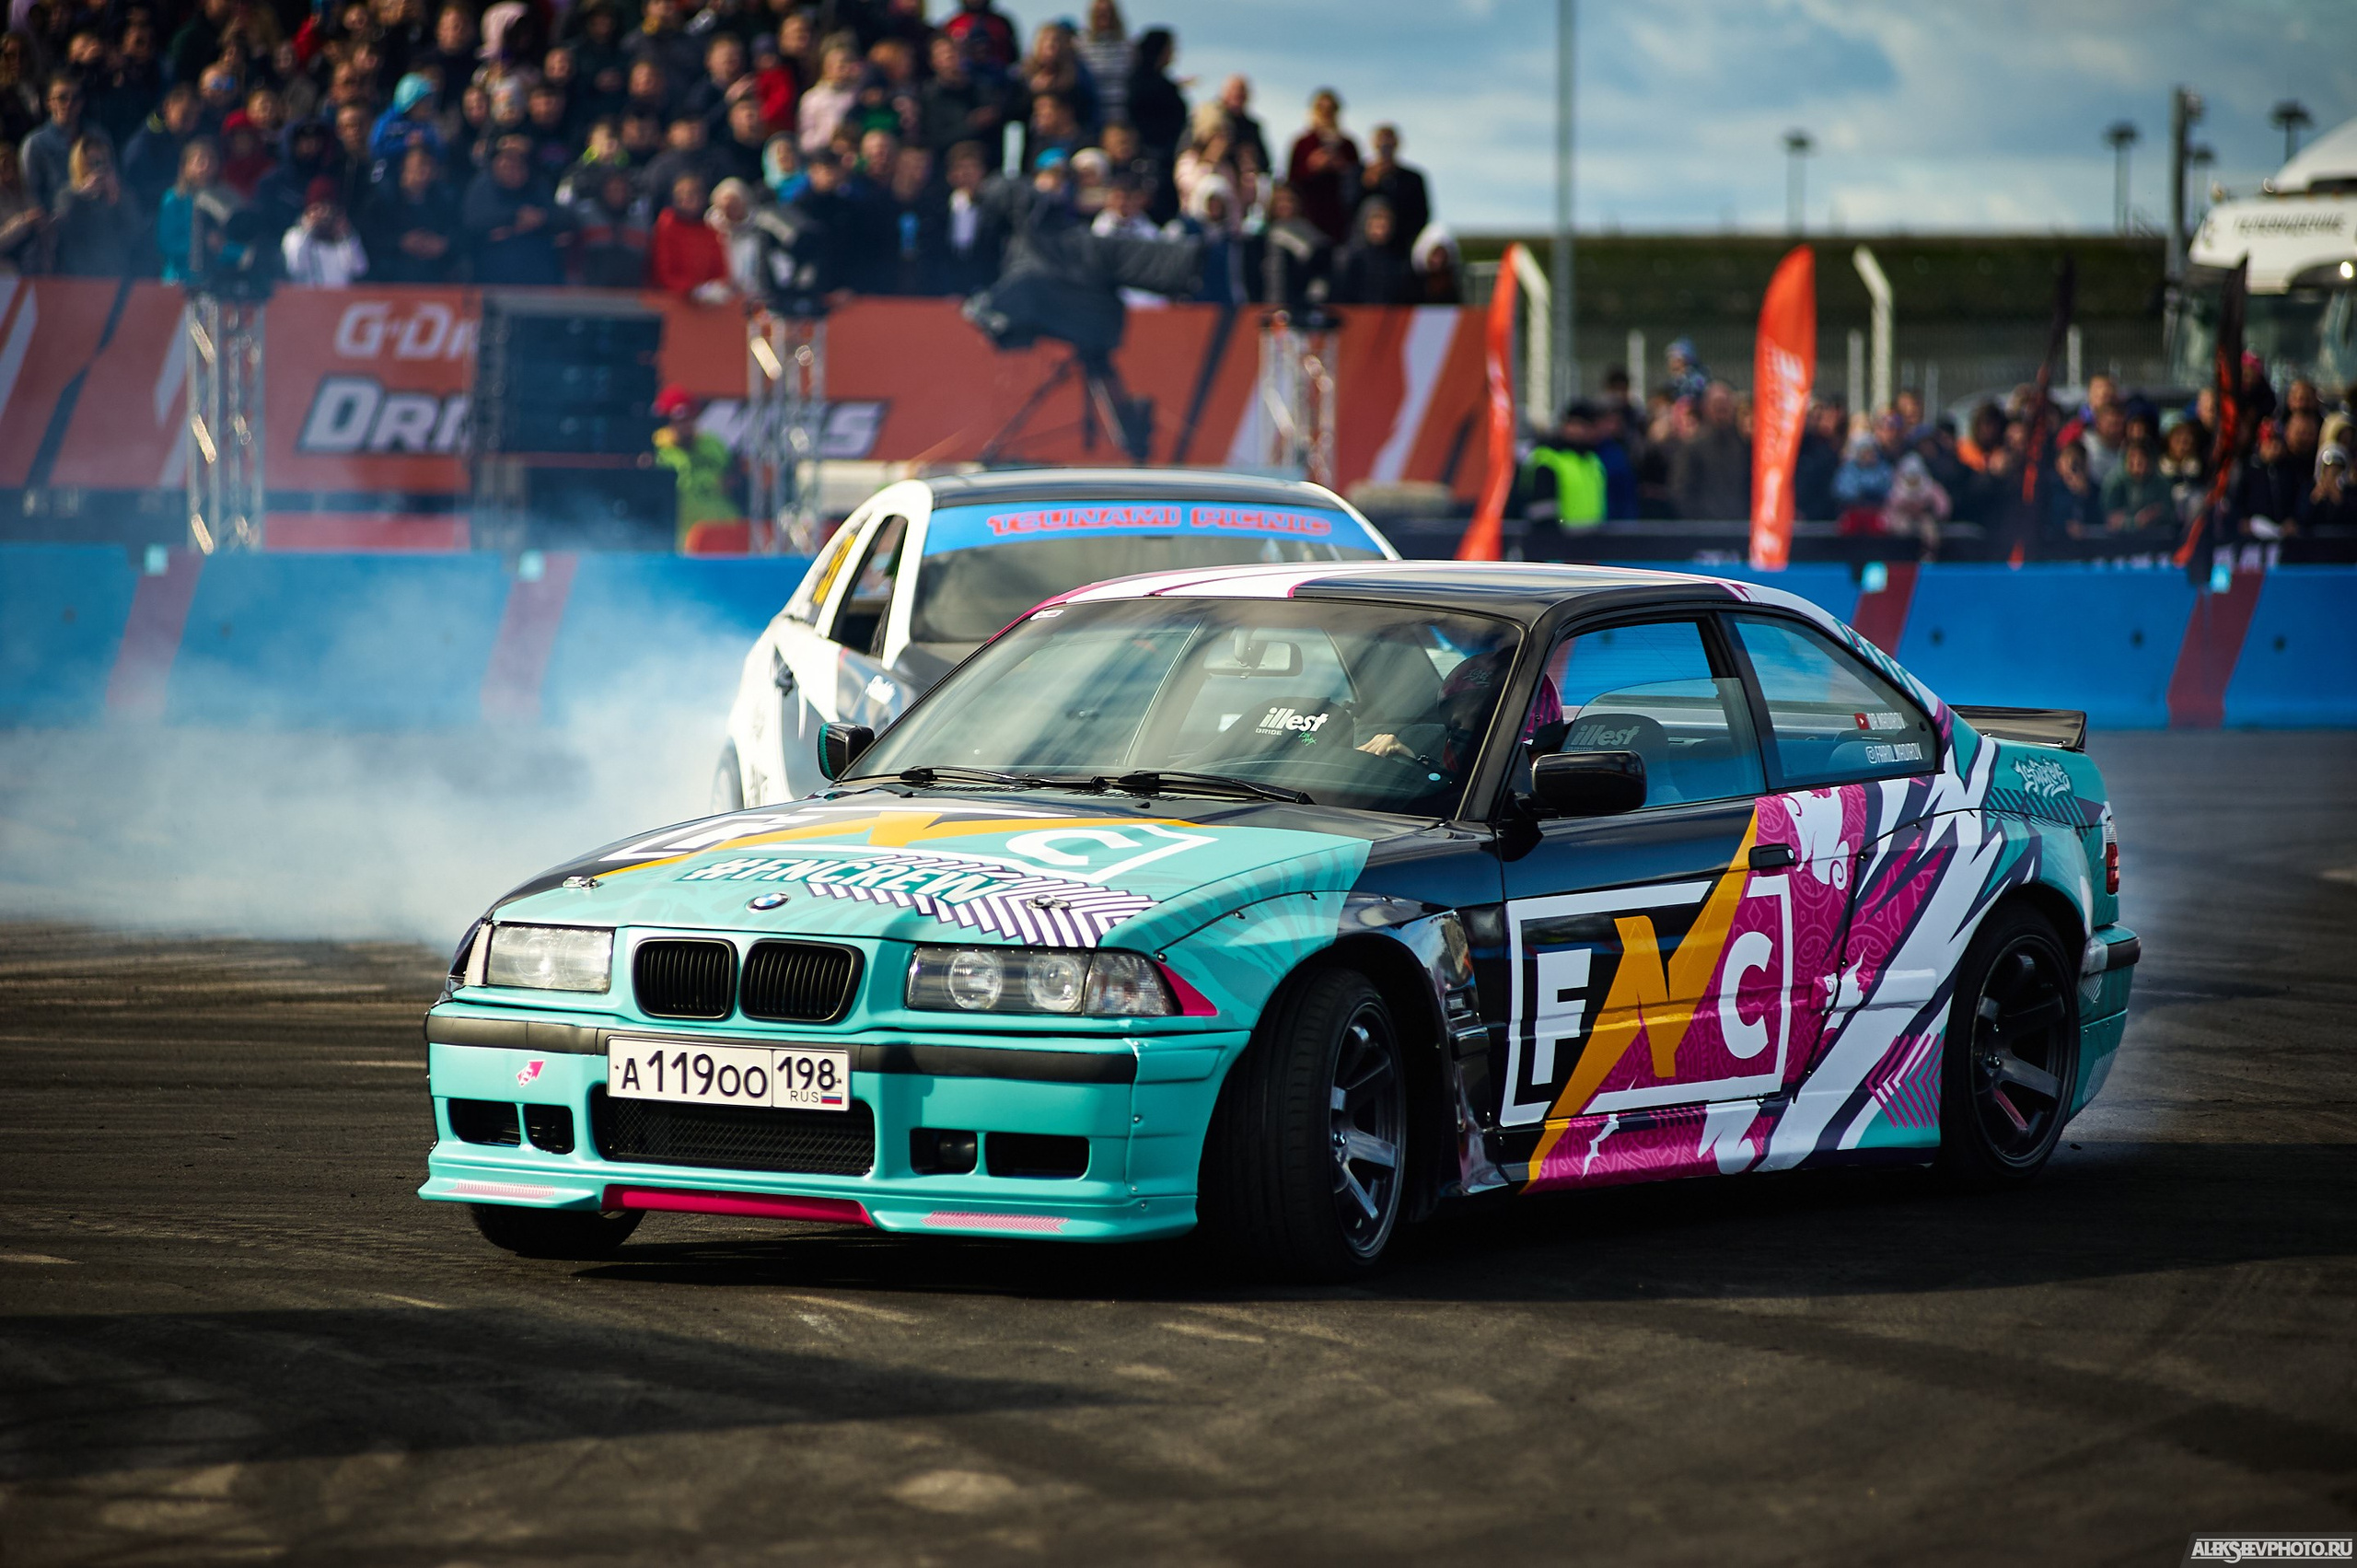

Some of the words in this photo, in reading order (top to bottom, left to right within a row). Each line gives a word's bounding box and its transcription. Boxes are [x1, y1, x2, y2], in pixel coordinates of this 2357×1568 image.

[987, 506, 1181, 536] TSUNAMI
[1190, 507, 1331, 536] PICNIC
[1259, 707, 1329, 732] illest
[1571, 725, 1640, 746] illest
[776, 1056, 835, 1091] 198
[790, 1090, 819, 1103] RUS
